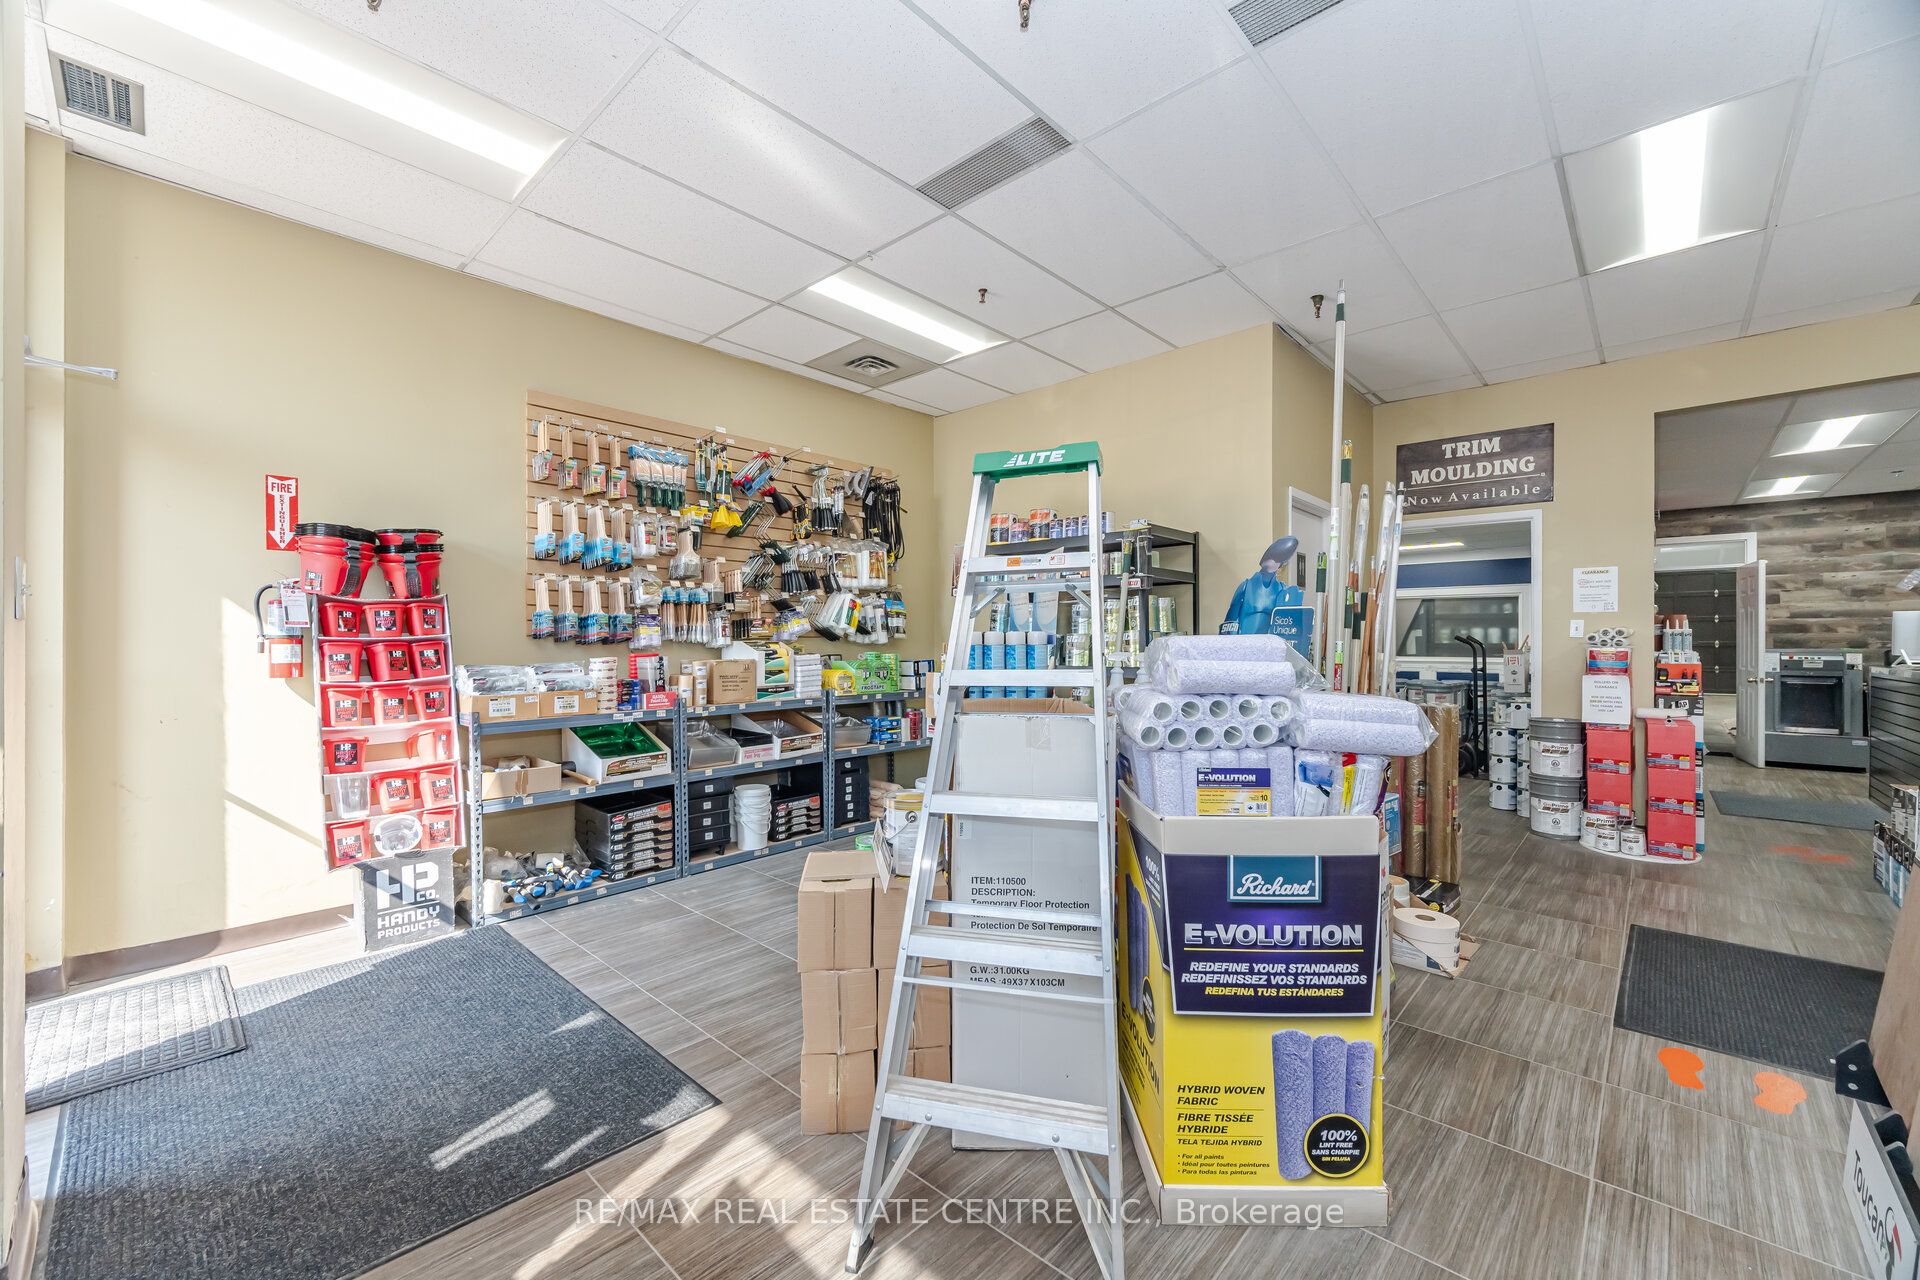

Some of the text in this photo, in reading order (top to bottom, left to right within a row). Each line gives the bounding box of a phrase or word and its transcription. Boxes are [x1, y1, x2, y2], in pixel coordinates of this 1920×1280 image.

[1442, 436, 1501, 459] TRIM
[1002, 450, 1066, 468] ELITE
[1410, 456, 1536, 485] MOULDING
[271, 482, 292, 494] FIRE
[1407, 484, 1541, 506] Now Available
[1274, 616, 1293, 625] Sico's
[1220, 622, 1239, 632] SICO
[1273, 626, 1297, 635] Unique
[1198, 774, 1256, 782] E-VOLUTION
[1586, 816, 1615, 824] GoPrime
[376, 862, 439, 910] HP
[971, 877, 1026, 885] ITEM:110500
[1236, 873, 1312, 894] Richard
[416, 889, 440, 901] CO.
[971, 888, 1036, 897] DESCRIPTION:
[1020, 900, 1043, 908] Floor
[1045, 901, 1090, 909] Protection
[378, 905, 440, 929] HANDY
[378, 919, 440, 939] PRODUCTS
[970, 921, 1015, 930] Protection
[1018, 922, 1029, 930] De
[1048, 923, 1097, 932] Temporaire
[1184, 923, 1362, 946] E-VOLUTION
[1190, 962, 1359, 973] REDEFINE YOUR STANDARDS
[1181, 974, 1367, 985] REDEFINISSEZ VOS STANDARDS
[1205, 986, 1344, 996] REDEFINA TUS ESTÁNDARES
[1177, 1085, 1265, 1094] HYBRID WOVEN
[1177, 1097, 1218, 1105] FABRIC
[1177, 1112, 1254, 1122] FIBRE TISSÉE
[1177, 1125, 1228, 1133] HYBRIDE
[1321, 1130, 1357, 1141] 100%
